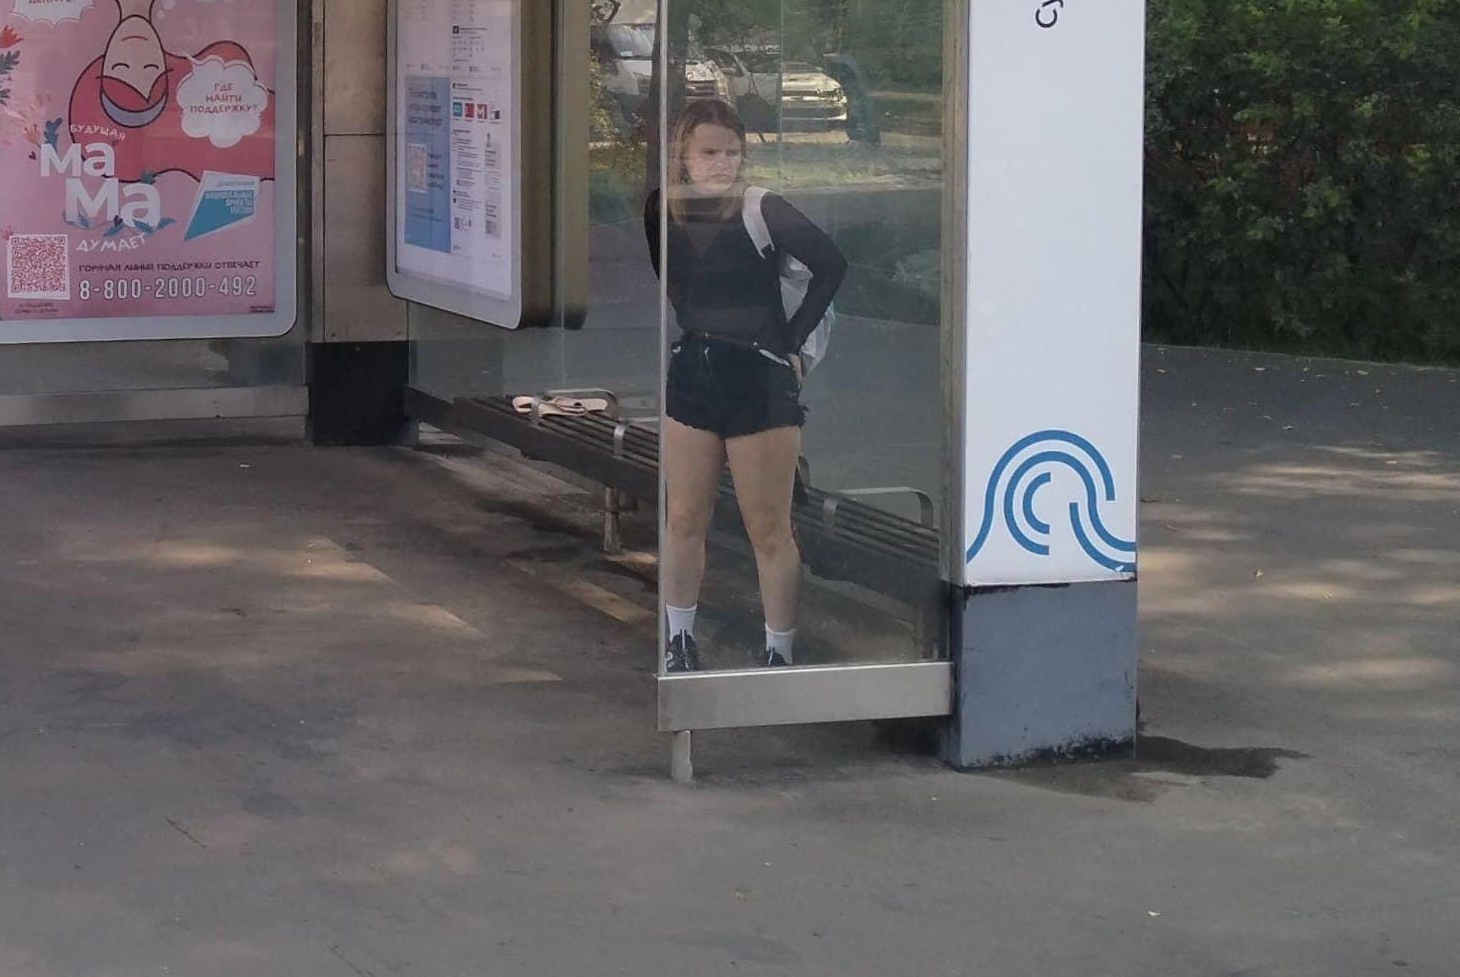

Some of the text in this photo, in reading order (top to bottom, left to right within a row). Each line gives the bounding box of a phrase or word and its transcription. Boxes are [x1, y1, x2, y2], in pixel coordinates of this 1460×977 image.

[213, 82, 235, 92] ГДЕ
[205, 93, 243, 103] НАЙТИ
[189, 104, 258, 114] ПОДДЕРЖКУ?
[70, 123, 126, 141] БУДУЩАЯ
[75, 232, 147, 252] ДУМАЕТ
[78, 263, 121, 272] ГОРЯЧАЯ
[214, 260, 260, 269] ОТВЕЧАЕТ
[79, 276, 257, 300] 8-800-2000-492
